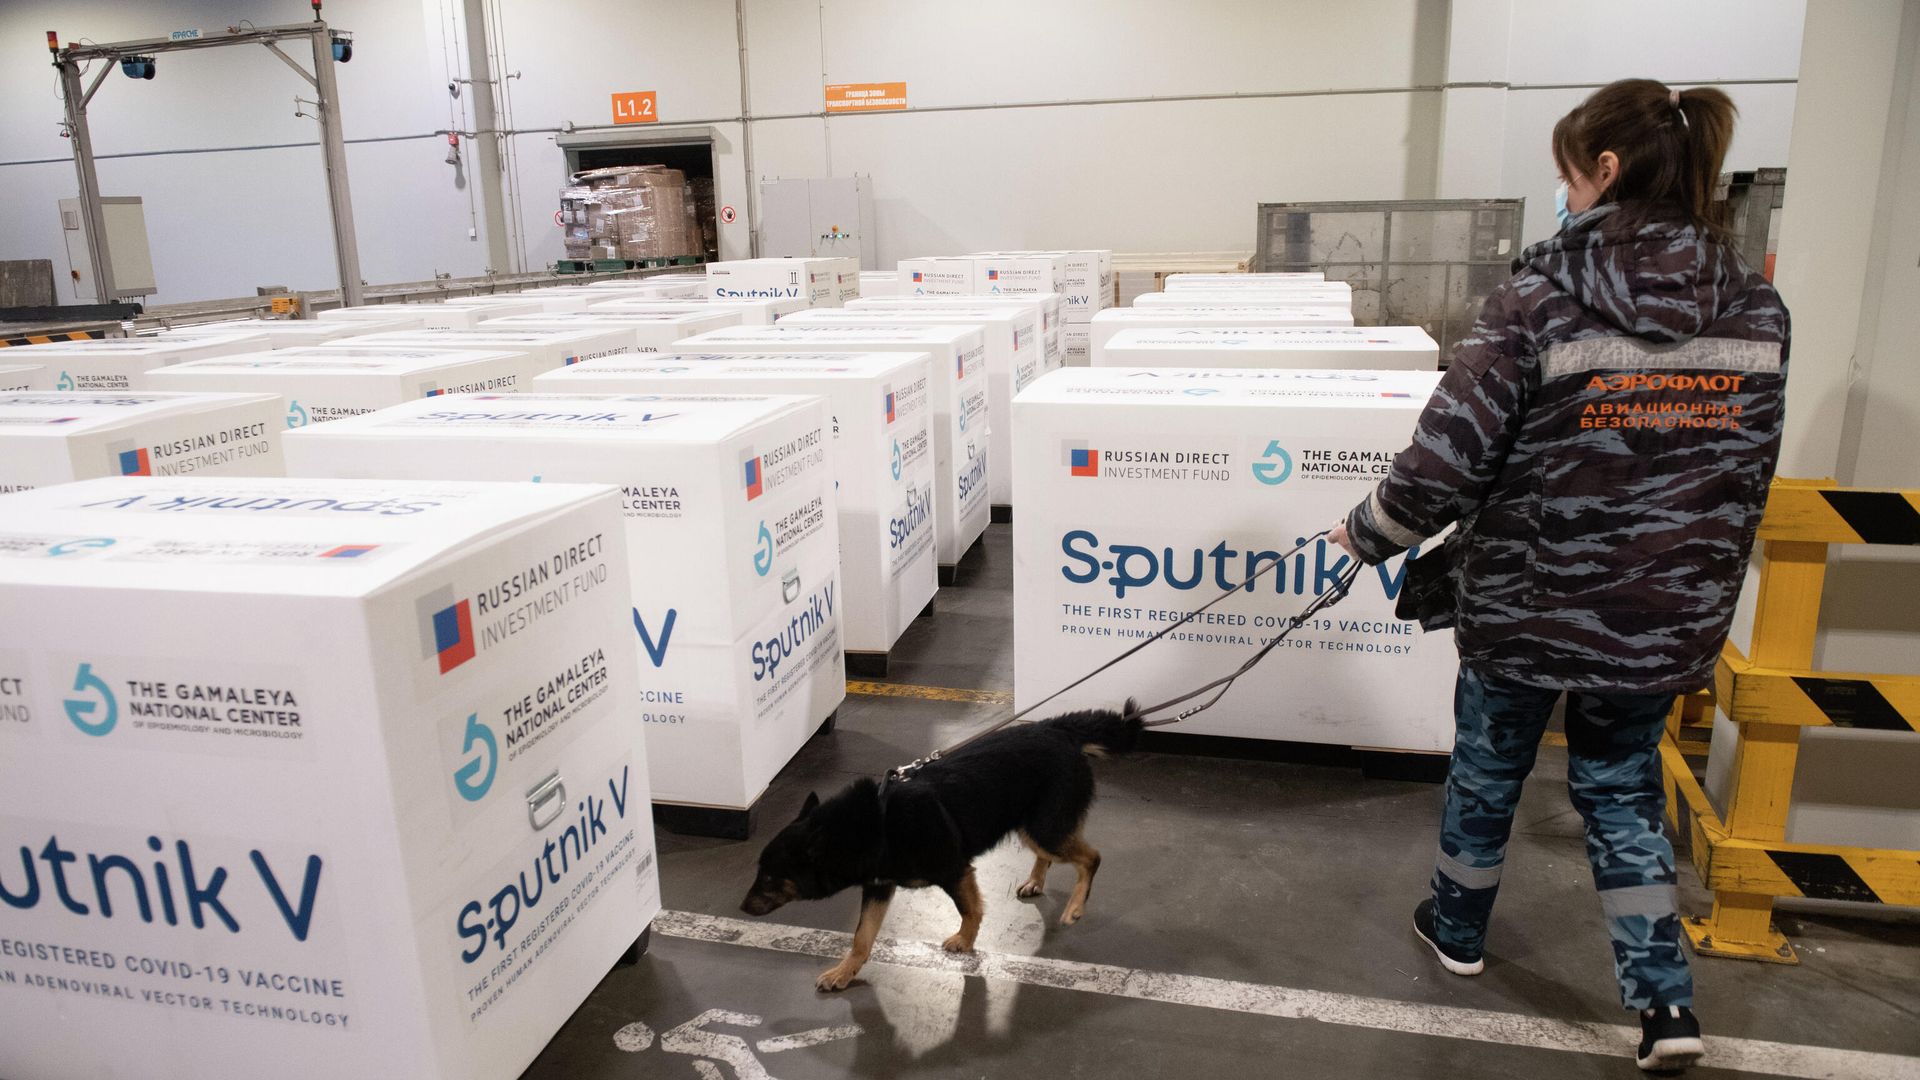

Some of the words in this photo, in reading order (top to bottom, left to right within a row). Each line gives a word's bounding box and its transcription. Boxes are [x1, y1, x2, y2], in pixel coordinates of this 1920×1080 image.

[617, 98, 652, 117] L1.2
[488, 375, 517, 390] DIRECT
[1586, 374, 1744, 393] АЭРОФЛОТ
[311, 407, 328, 415] THE
[1580, 416, 1740, 431] БЕЗОПАСНОСТЬ
[1583, 402, 1742, 417] АВИАЦИОННАЯ
[154, 433, 216, 459] RUSSIAN
[220, 423, 265, 444] DIRECT
[157, 448, 235, 477] INVESTMENT
[238, 440, 269, 458] FUND
[763, 440, 796, 469] RUSSIAN
[798, 428, 822, 451] DIRECT
[1104, 450, 1170, 464] RUSSIAN
[1175, 451, 1230, 465] DIRECT
[1303, 450, 1332, 461] THE
[1104, 467, 1189, 481] INVESTMENT
[1193, 468, 1230, 482] FUND
[1301, 463, 1367, 474] NATIONAL
[1371, 464, 1392, 475] CE
[632, 500, 681, 510] CENTER
[775, 517, 788, 534] THE
[789, 496, 823, 525] GAMALEYA
[476, 561, 549, 616] RUSSIAN
[553, 533, 603, 576] DIRECT
[1061, 529, 1350, 599] Sputnik
[1376, 545, 1420, 601] V
[480, 583, 569, 650] INVESTMENT
[573, 562, 607, 596] FUND
[1062, 603, 1092, 617] THE
[1099, 606, 1143, 620] FIRST
[1148, 609, 1247, 626] REGISTERED
[1339, 620, 1413, 636] VACCINE
[632, 606, 678, 668] V
[752, 593, 824, 682] Sputnik
[824, 580, 834, 617] V
[1062, 625, 1111, 636] PROVEN
[1117, 628, 1163, 640] HUMAN
[1170, 632, 1254, 646] ADENOVIRAL
[1319, 640, 1411, 655] TECHNOLOGY
[127, 681, 167, 699] THE
[175, 684, 298, 708] GAMALEYA
[503, 695, 533, 726] THE
[536, 648, 605, 704] GAMALEYA
[130, 702, 222, 722] NATIONAL
[227, 708, 301, 727] CENTER
[505, 697, 566, 749] NATIONAL
[567, 666, 608, 704] CENTER
[456, 794, 607, 964] Sputnik
[608, 765, 628, 820] V
[250, 848, 323, 943] V
[467, 976, 490, 1002] THE
[491, 947, 519, 982] FIRST
[520, 896, 570, 953] REGISTERED
[570, 859, 605, 901] COVID-19
[605, 829, 635, 865] VACCINE
[124, 954, 230, 984] COVID-19
[238, 968, 346, 998] VACCINE
[470, 985, 504, 1023] PROVEN
[505, 958, 534, 990] HUMAN
[24, 973, 135, 1000] ADENOVIRAL
[140, 988, 213, 1011] VECTOR
[219, 999, 349, 1029] TECHNOLOGY
